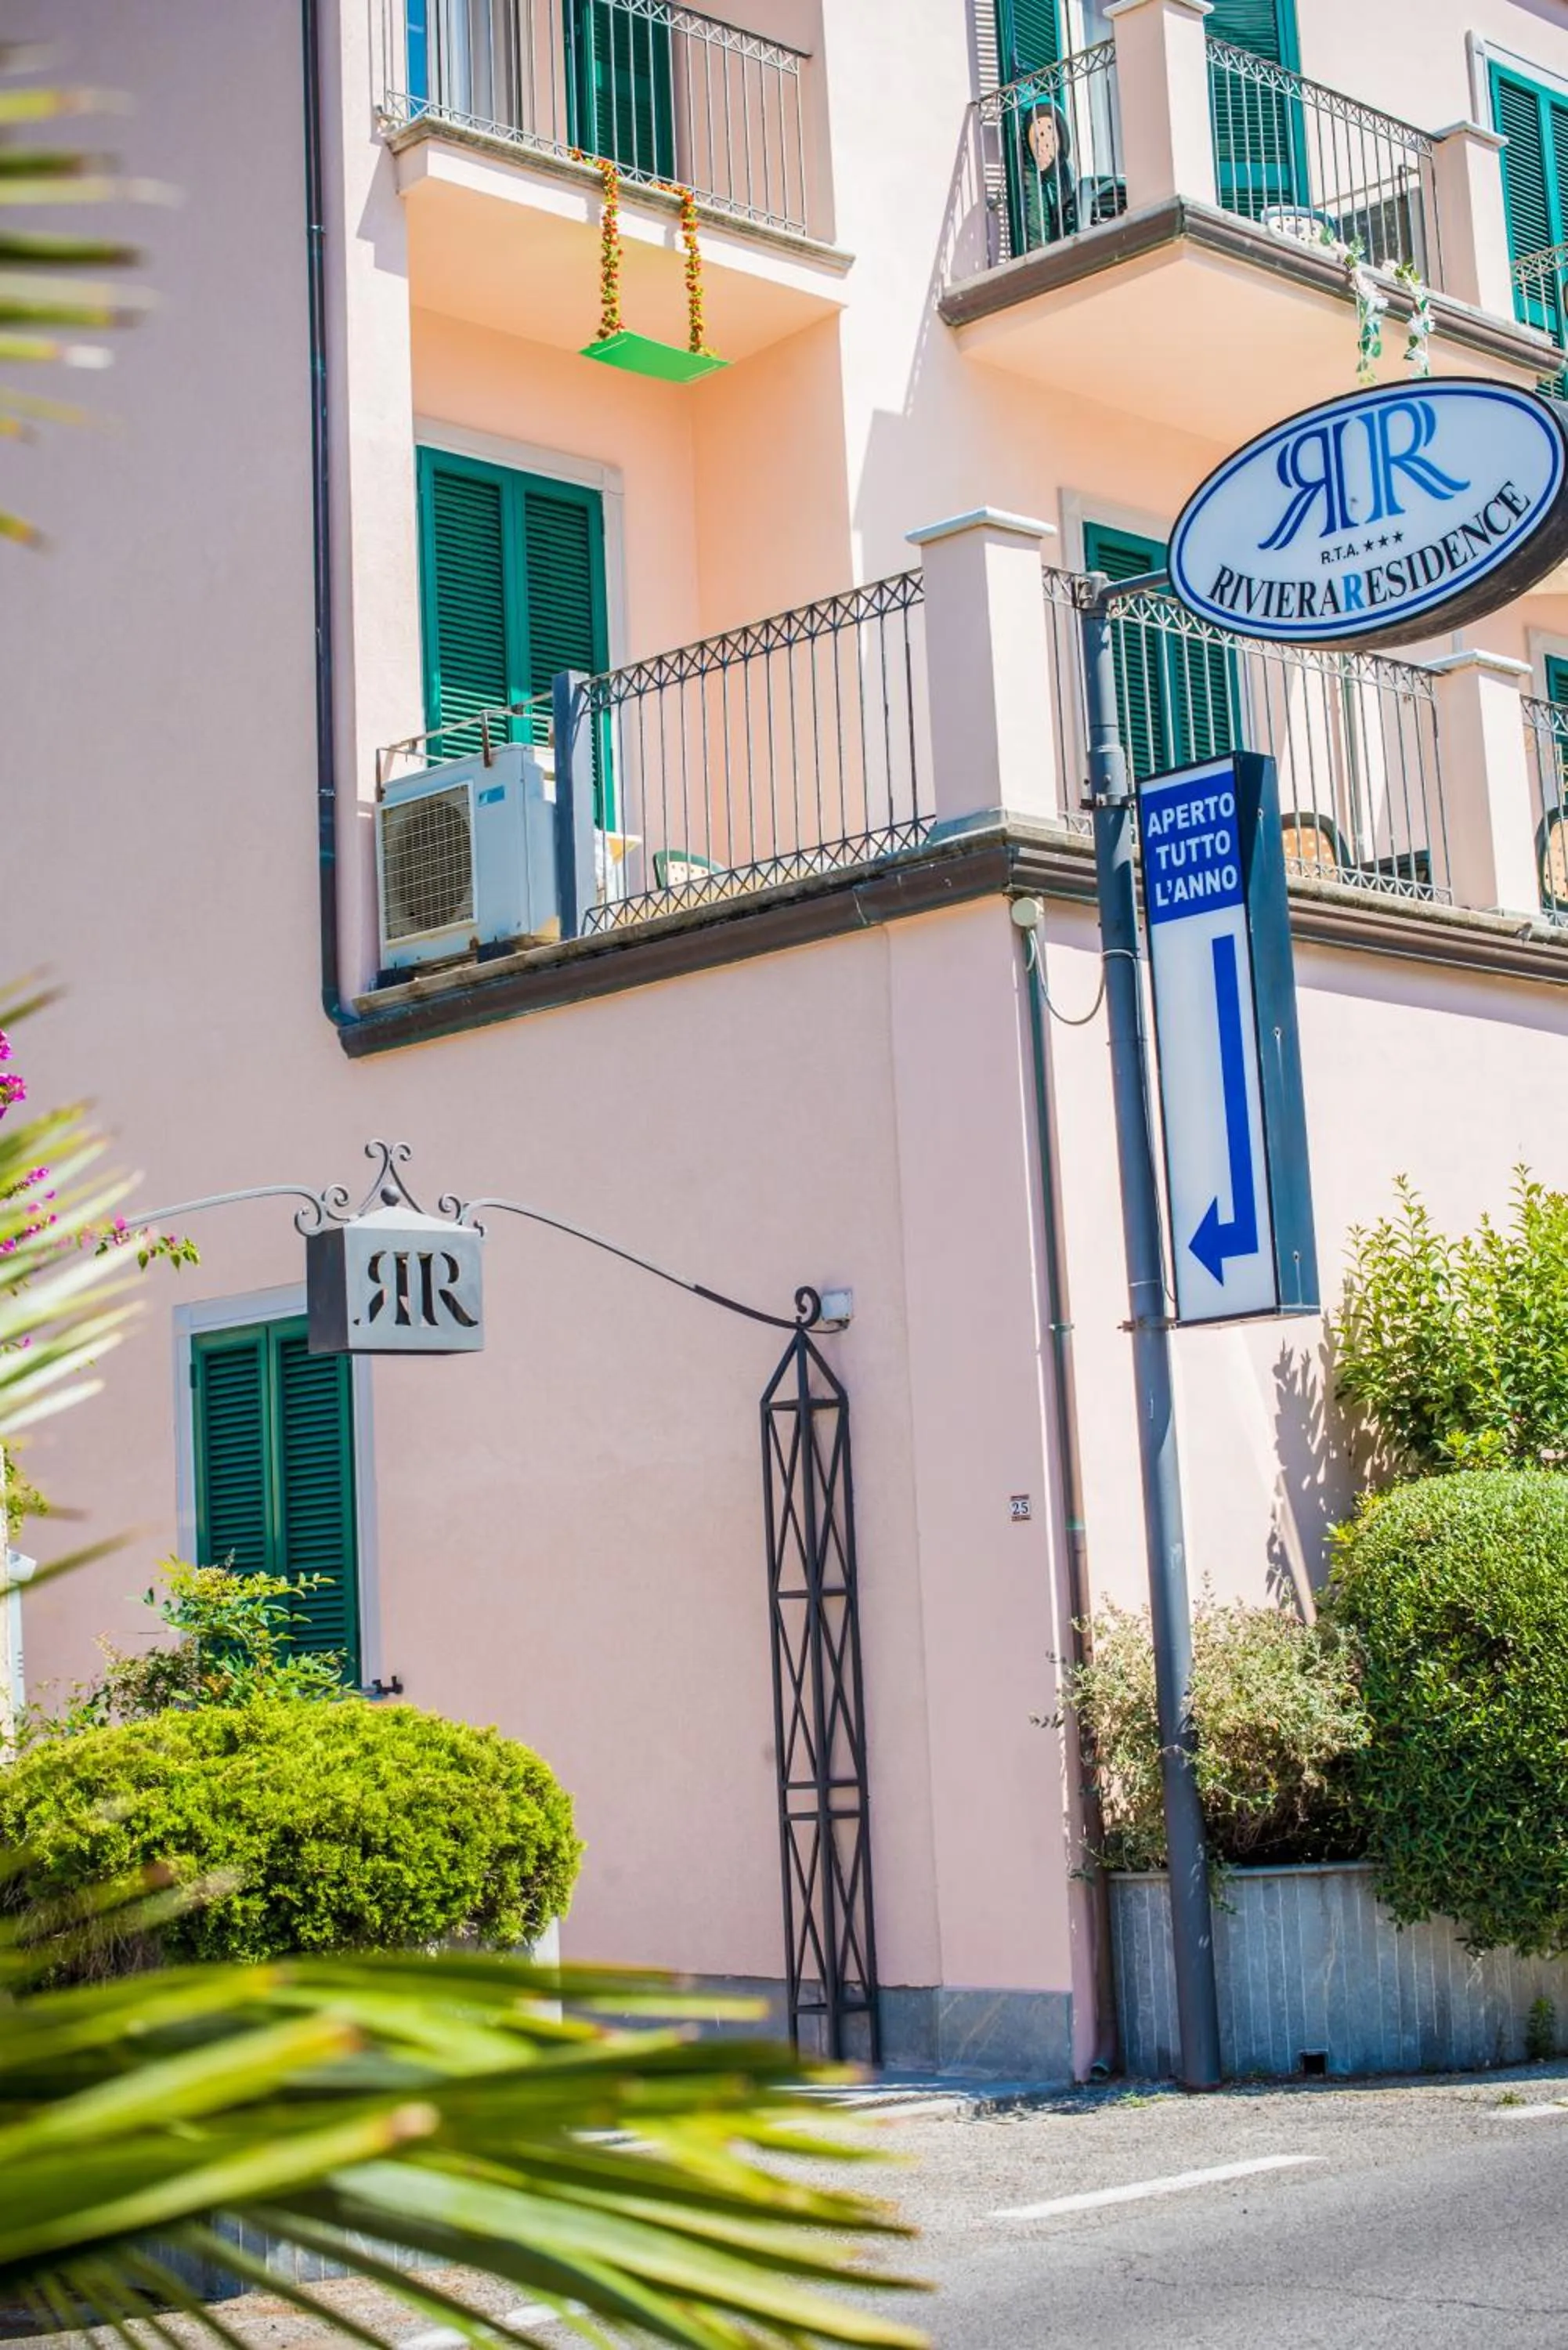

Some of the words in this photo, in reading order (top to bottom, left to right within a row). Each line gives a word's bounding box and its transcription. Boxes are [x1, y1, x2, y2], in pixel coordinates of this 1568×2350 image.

[1147, 792, 1235, 837] APERTO
[1155, 830, 1230, 870] TUTTO
[1154, 864, 1237, 907] L'ANNO
[1012, 1502, 1028, 1515] 25
